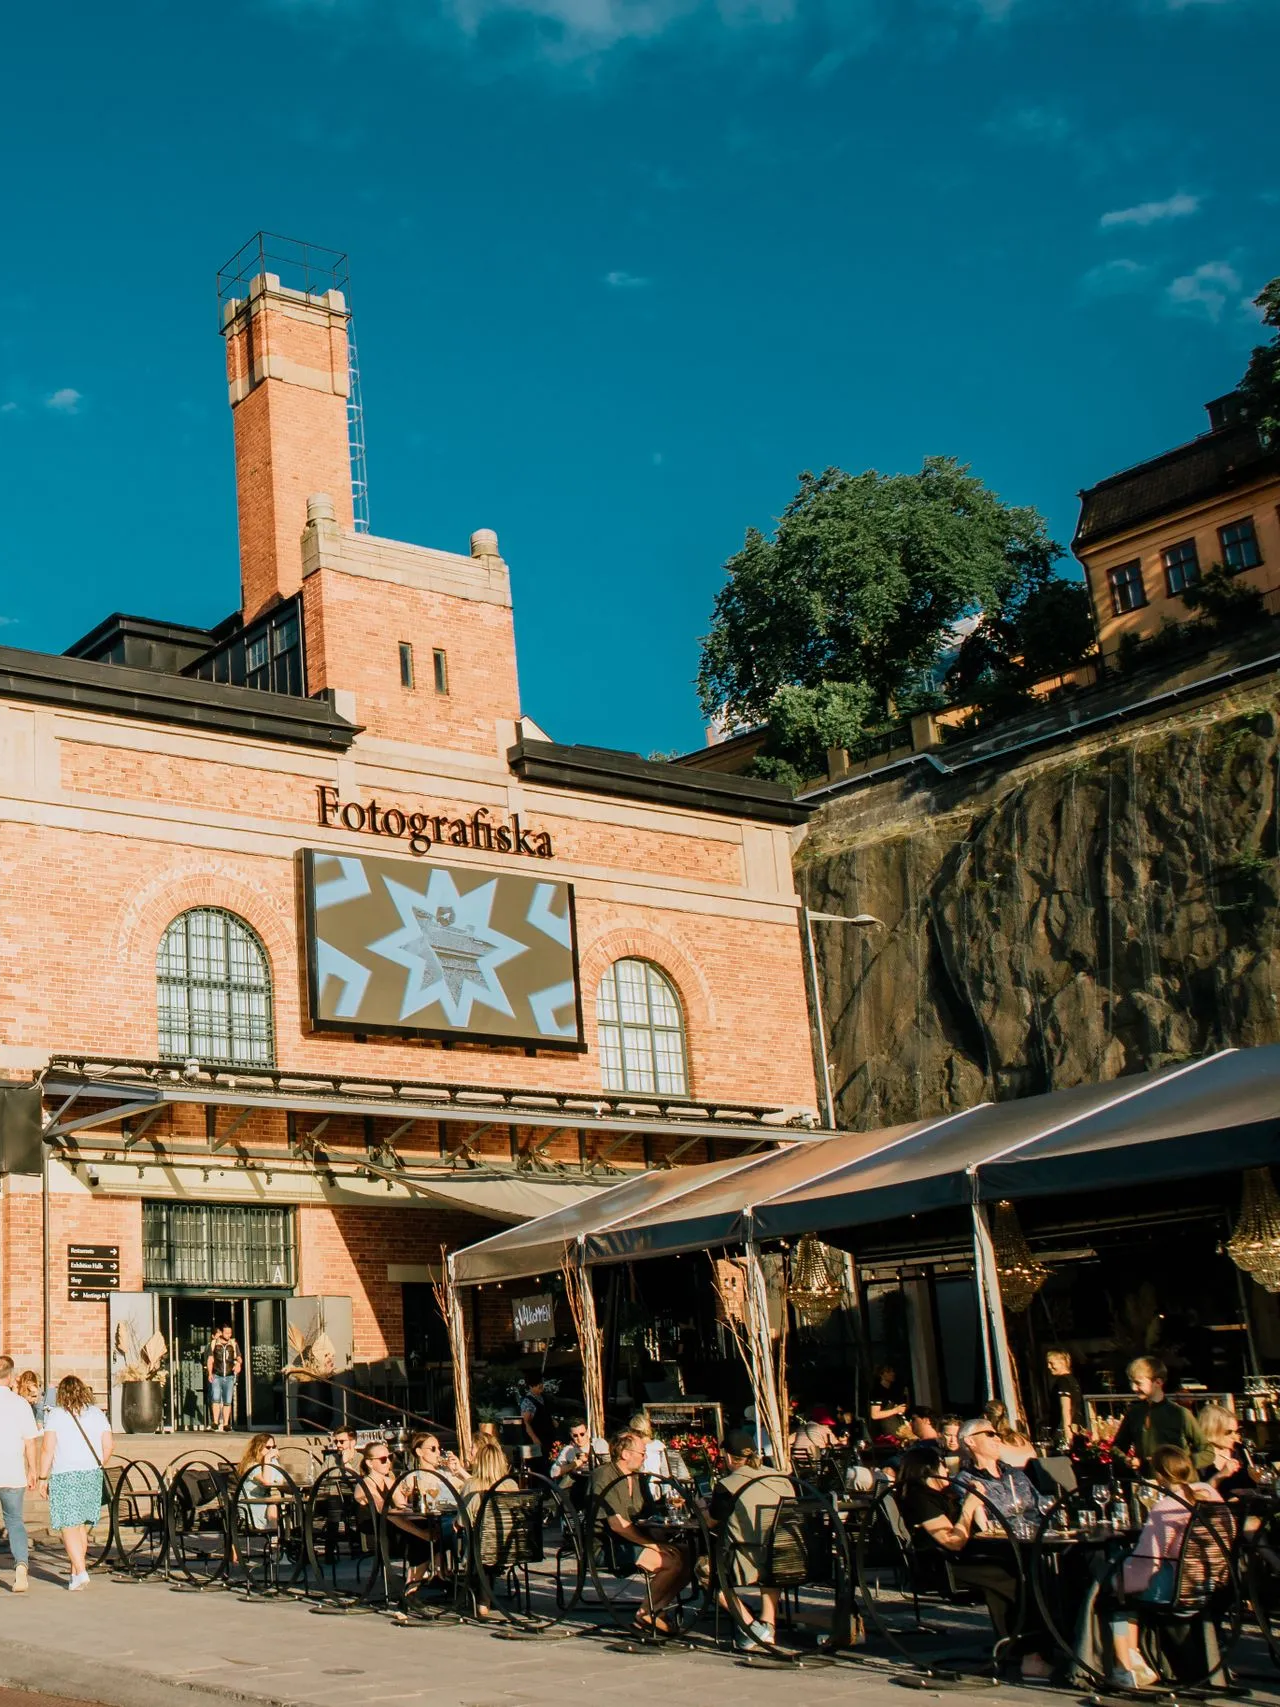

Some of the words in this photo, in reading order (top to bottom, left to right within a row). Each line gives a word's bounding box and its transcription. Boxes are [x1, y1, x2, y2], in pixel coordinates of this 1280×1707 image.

[316, 784, 554, 856] Fotografiska
[70, 1276, 82, 1285] Shop
[272, 1265, 284, 1283] A
